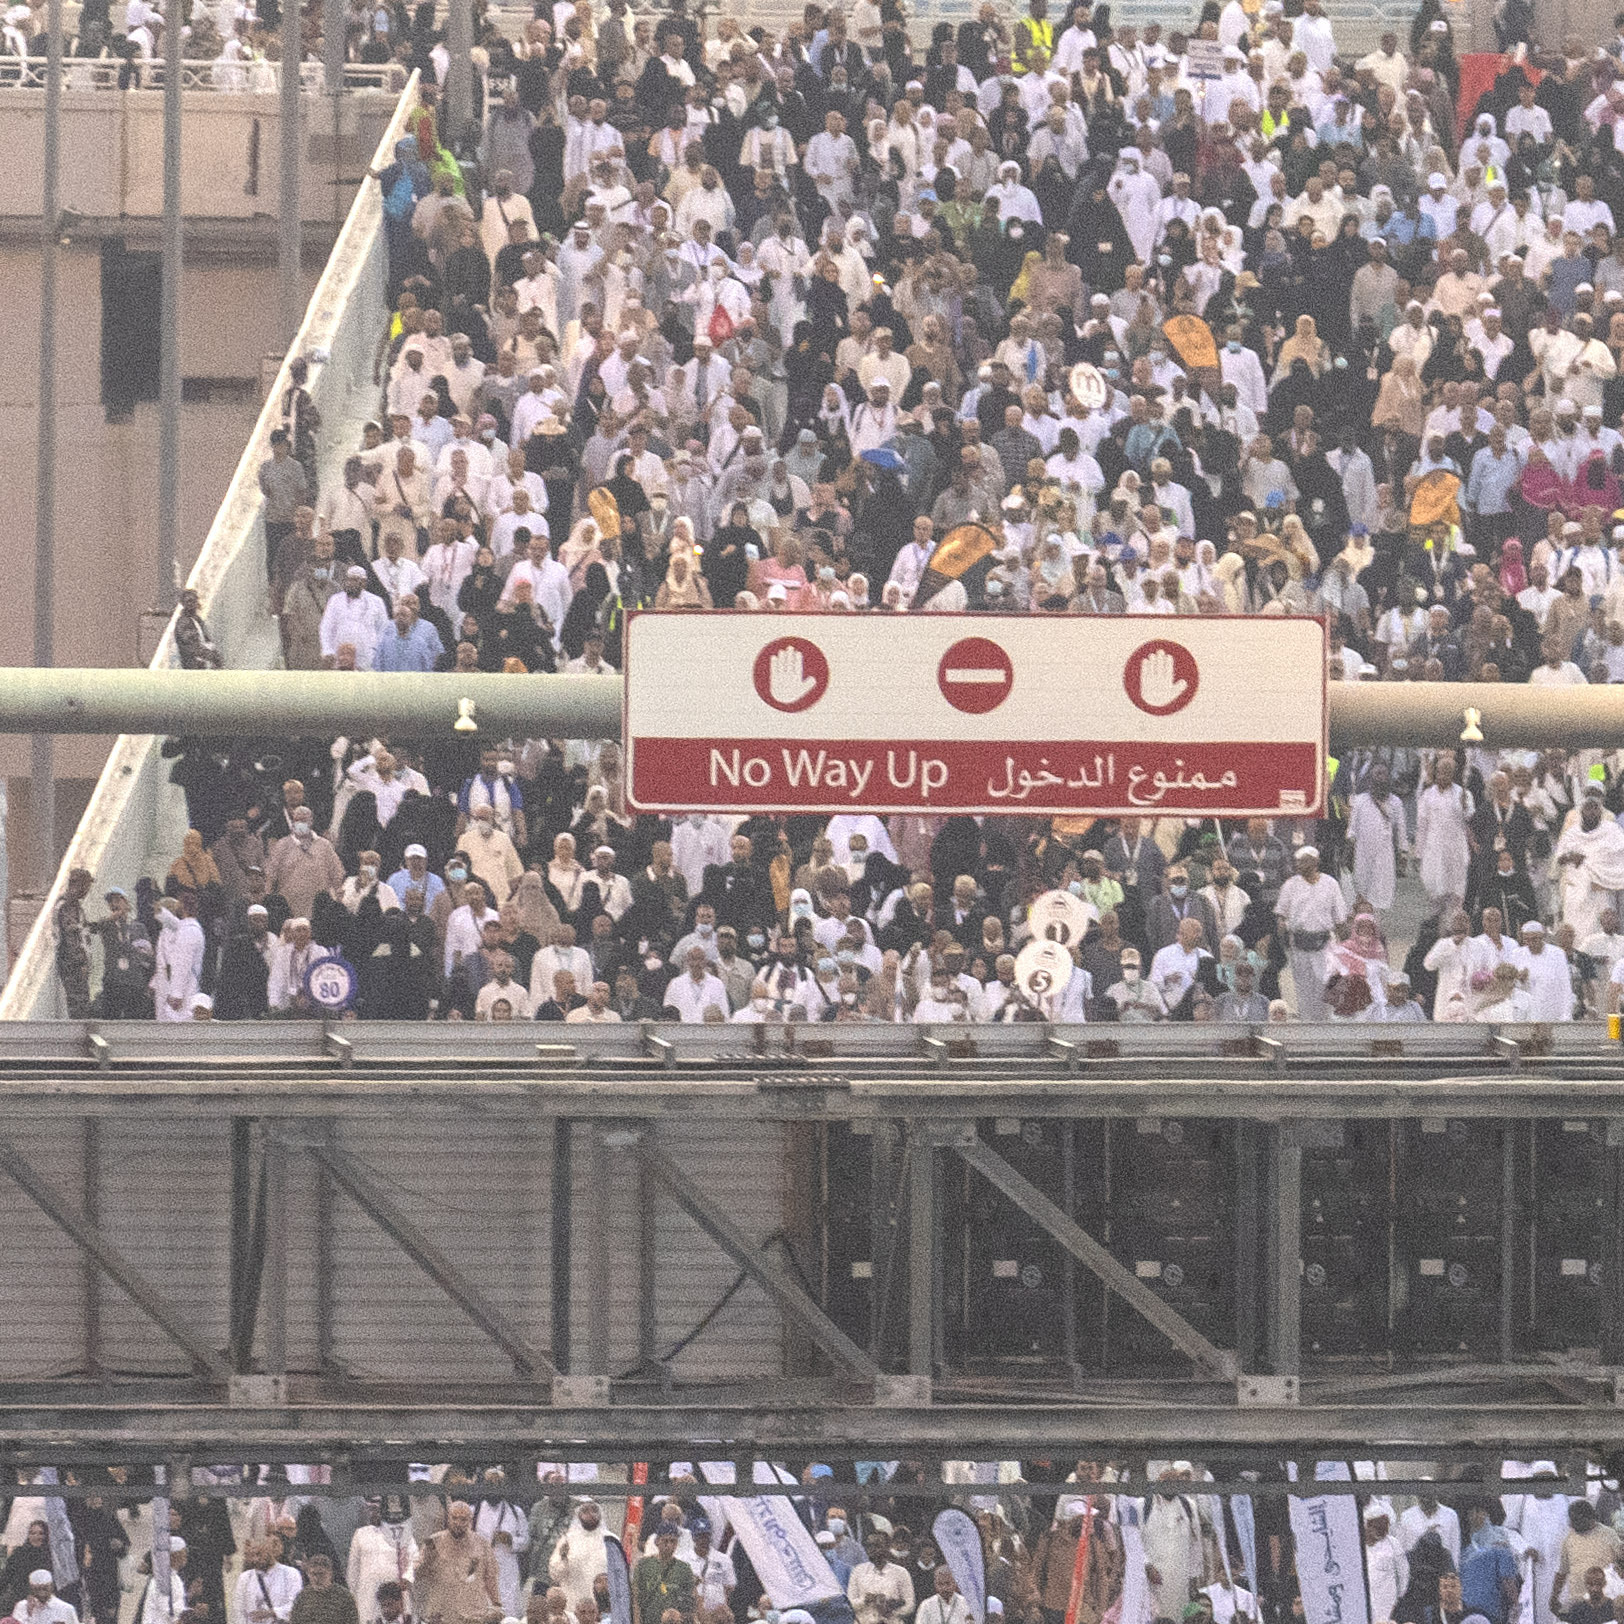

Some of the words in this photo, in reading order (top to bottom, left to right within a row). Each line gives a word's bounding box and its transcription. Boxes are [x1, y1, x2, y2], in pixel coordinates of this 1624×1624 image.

[710, 750, 772, 788] No
[780, 750, 876, 797] Way
[886, 750, 949, 797] Up
[987, 753, 1114, 800] الدخول
[1127, 760, 1238, 806] ممنوع
[320, 983, 340, 998] 80
